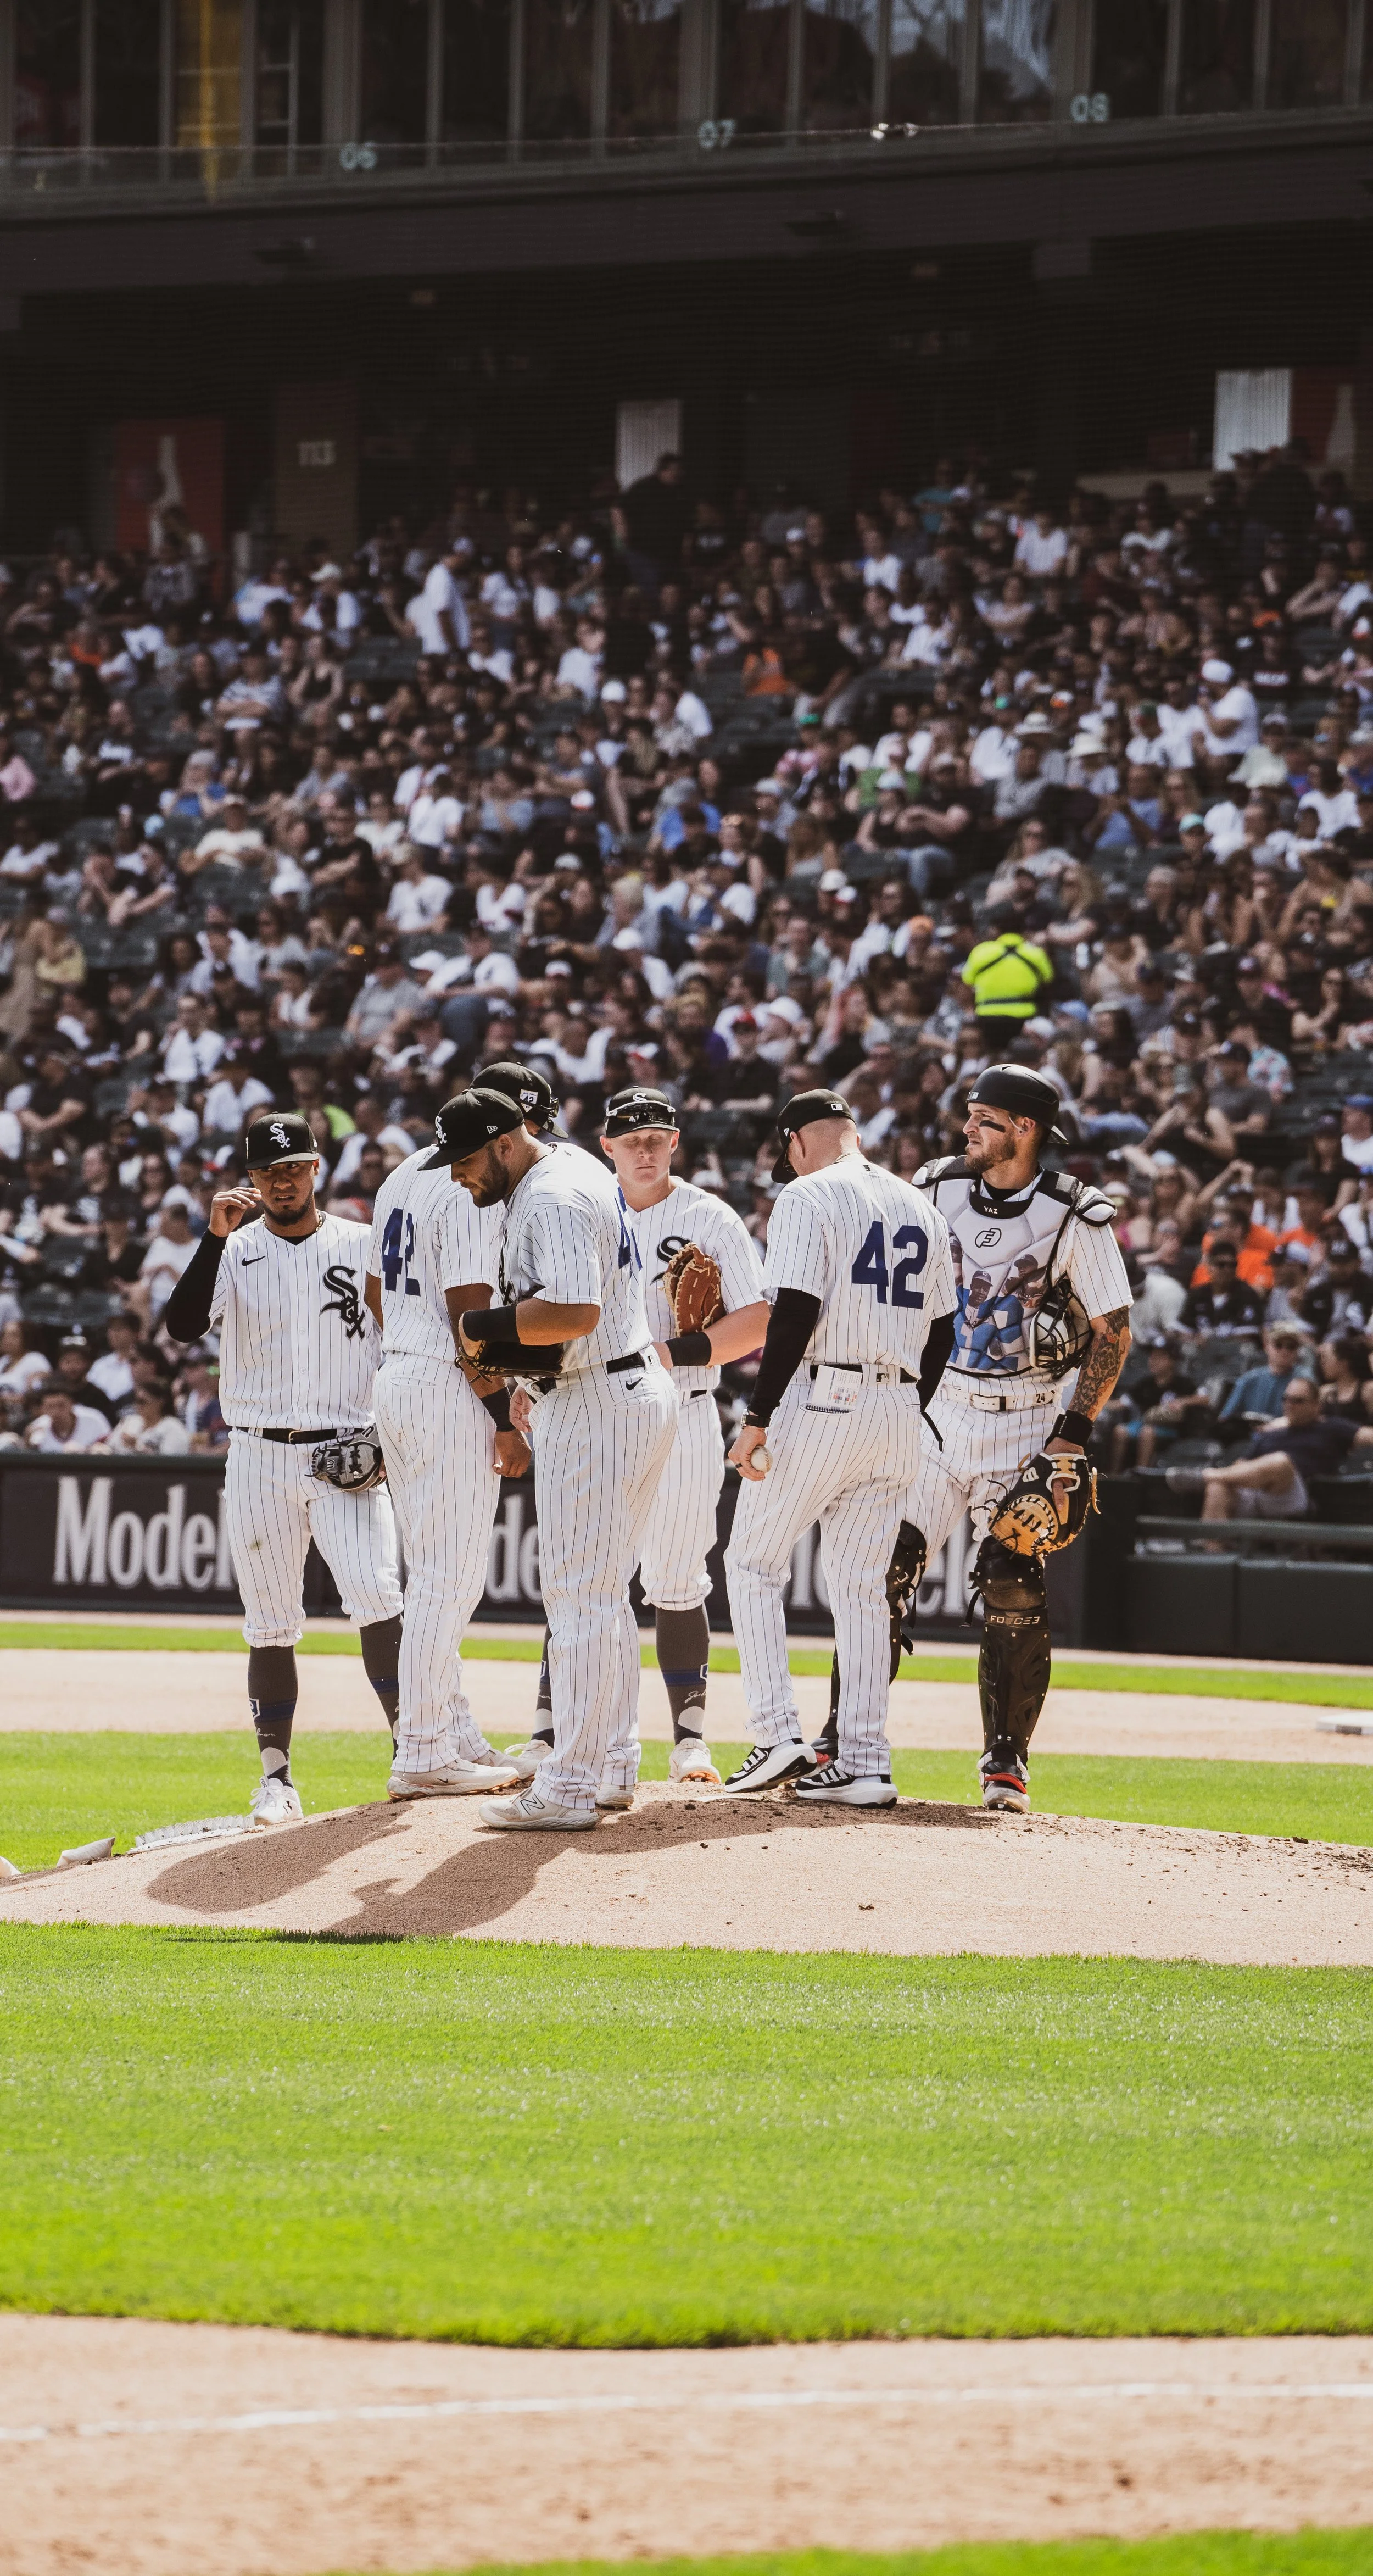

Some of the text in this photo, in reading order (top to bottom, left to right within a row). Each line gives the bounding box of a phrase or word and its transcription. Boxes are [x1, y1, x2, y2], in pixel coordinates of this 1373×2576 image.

[1070, 93, 1110, 123] 08
[698, 119, 736, 148] 07
[984, 1206, 998, 1214] YAZ
[382, 1208, 421, 1297] 42
[852, 1220, 929, 1310] 42
[1036, 1392, 1046, 1404] 24
[53, 1475, 238, 1591] Model
[990, 1615, 1040, 1624] FOCE3
